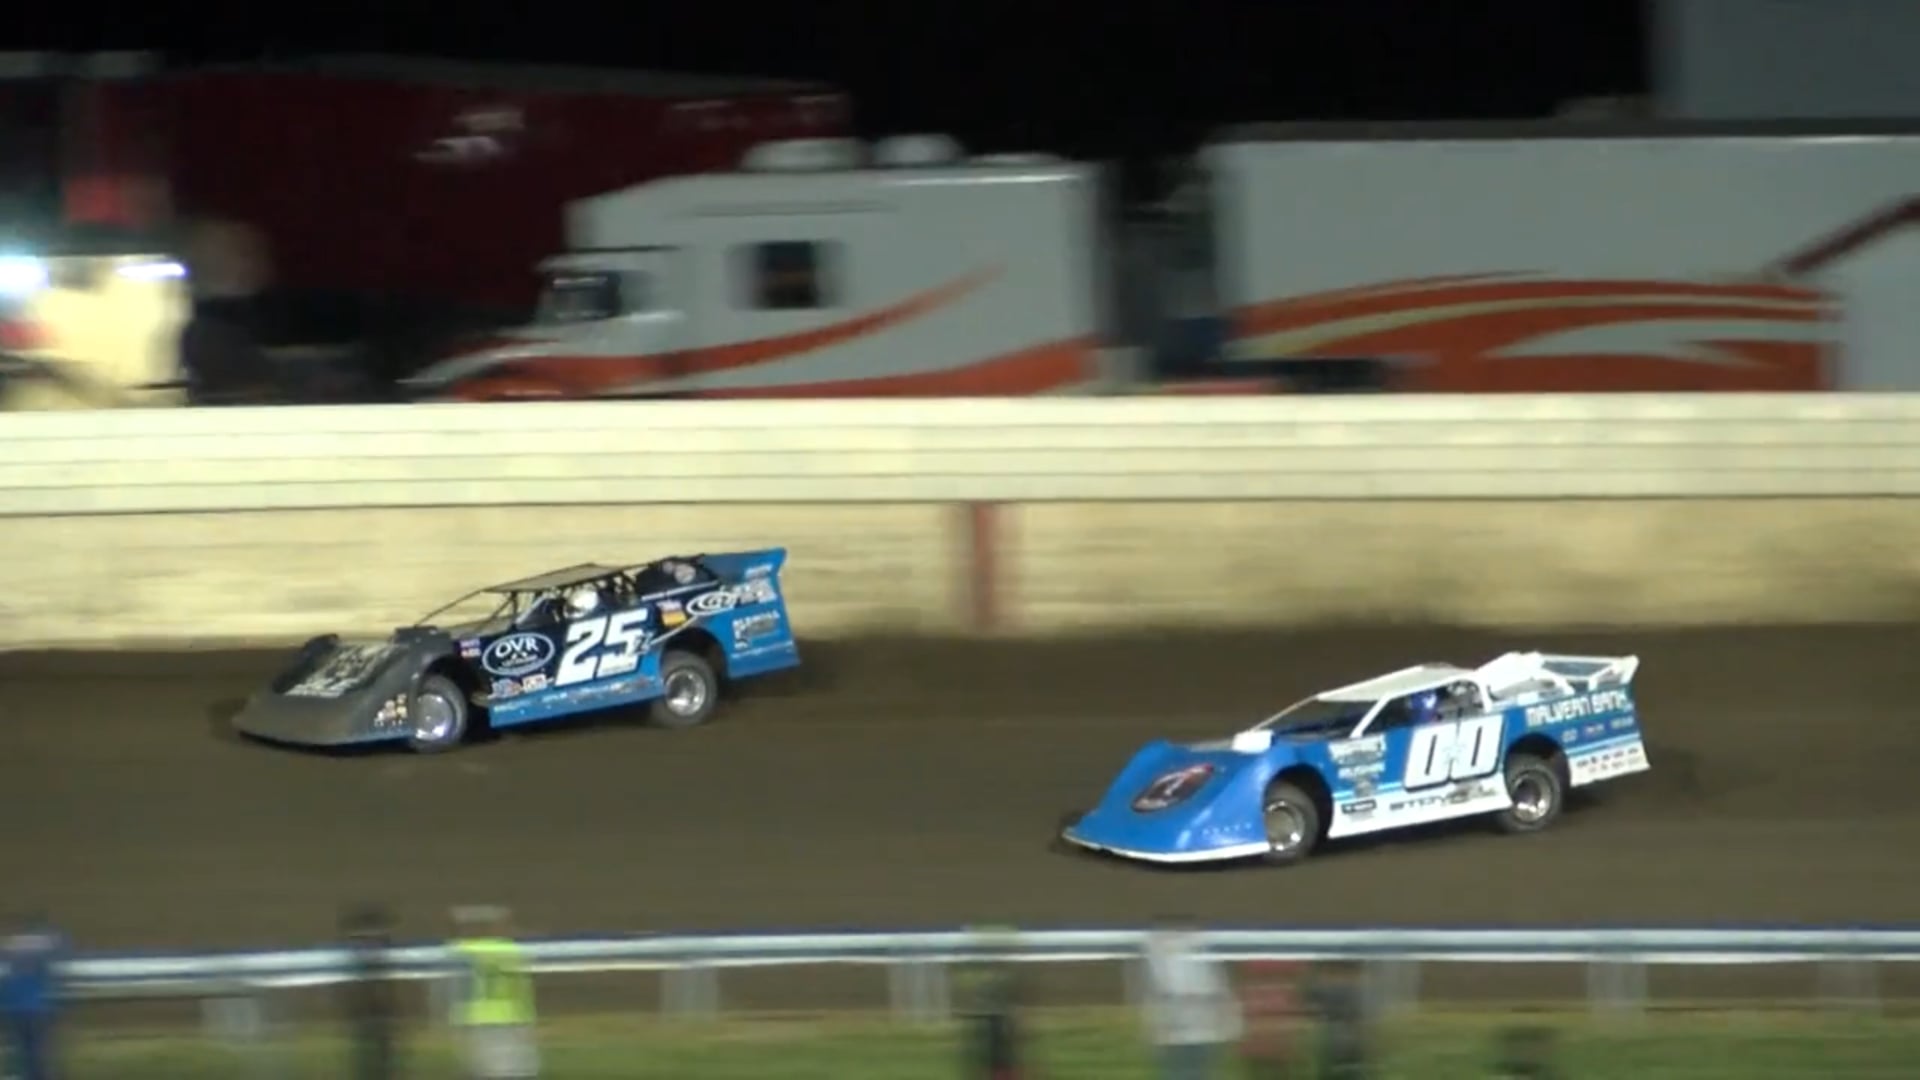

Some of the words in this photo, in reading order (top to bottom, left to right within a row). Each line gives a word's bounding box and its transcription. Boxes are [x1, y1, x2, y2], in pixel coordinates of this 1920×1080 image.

[495, 636, 539, 660] OVR
[554, 609, 648, 687] 25
[1403, 714, 1503, 793] 00
